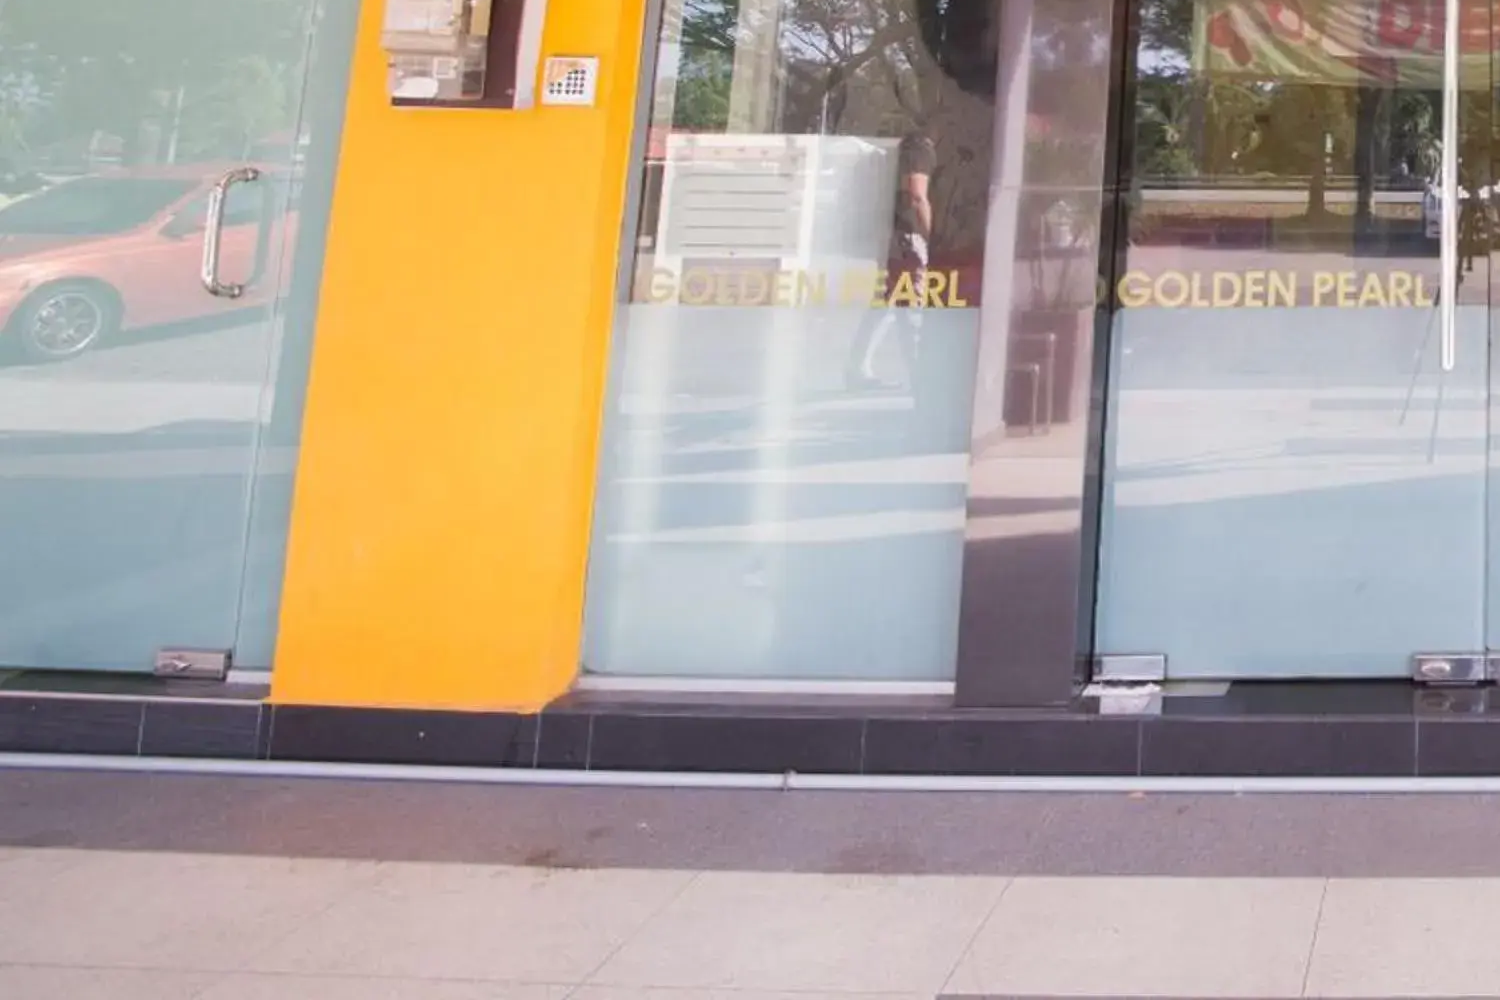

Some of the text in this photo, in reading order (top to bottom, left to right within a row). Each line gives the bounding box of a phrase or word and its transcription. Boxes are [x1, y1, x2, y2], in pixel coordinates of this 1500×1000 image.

[648, 266, 826, 307] GOLDEN
[1117, 269, 1435, 309] GOLDEN PEARL
